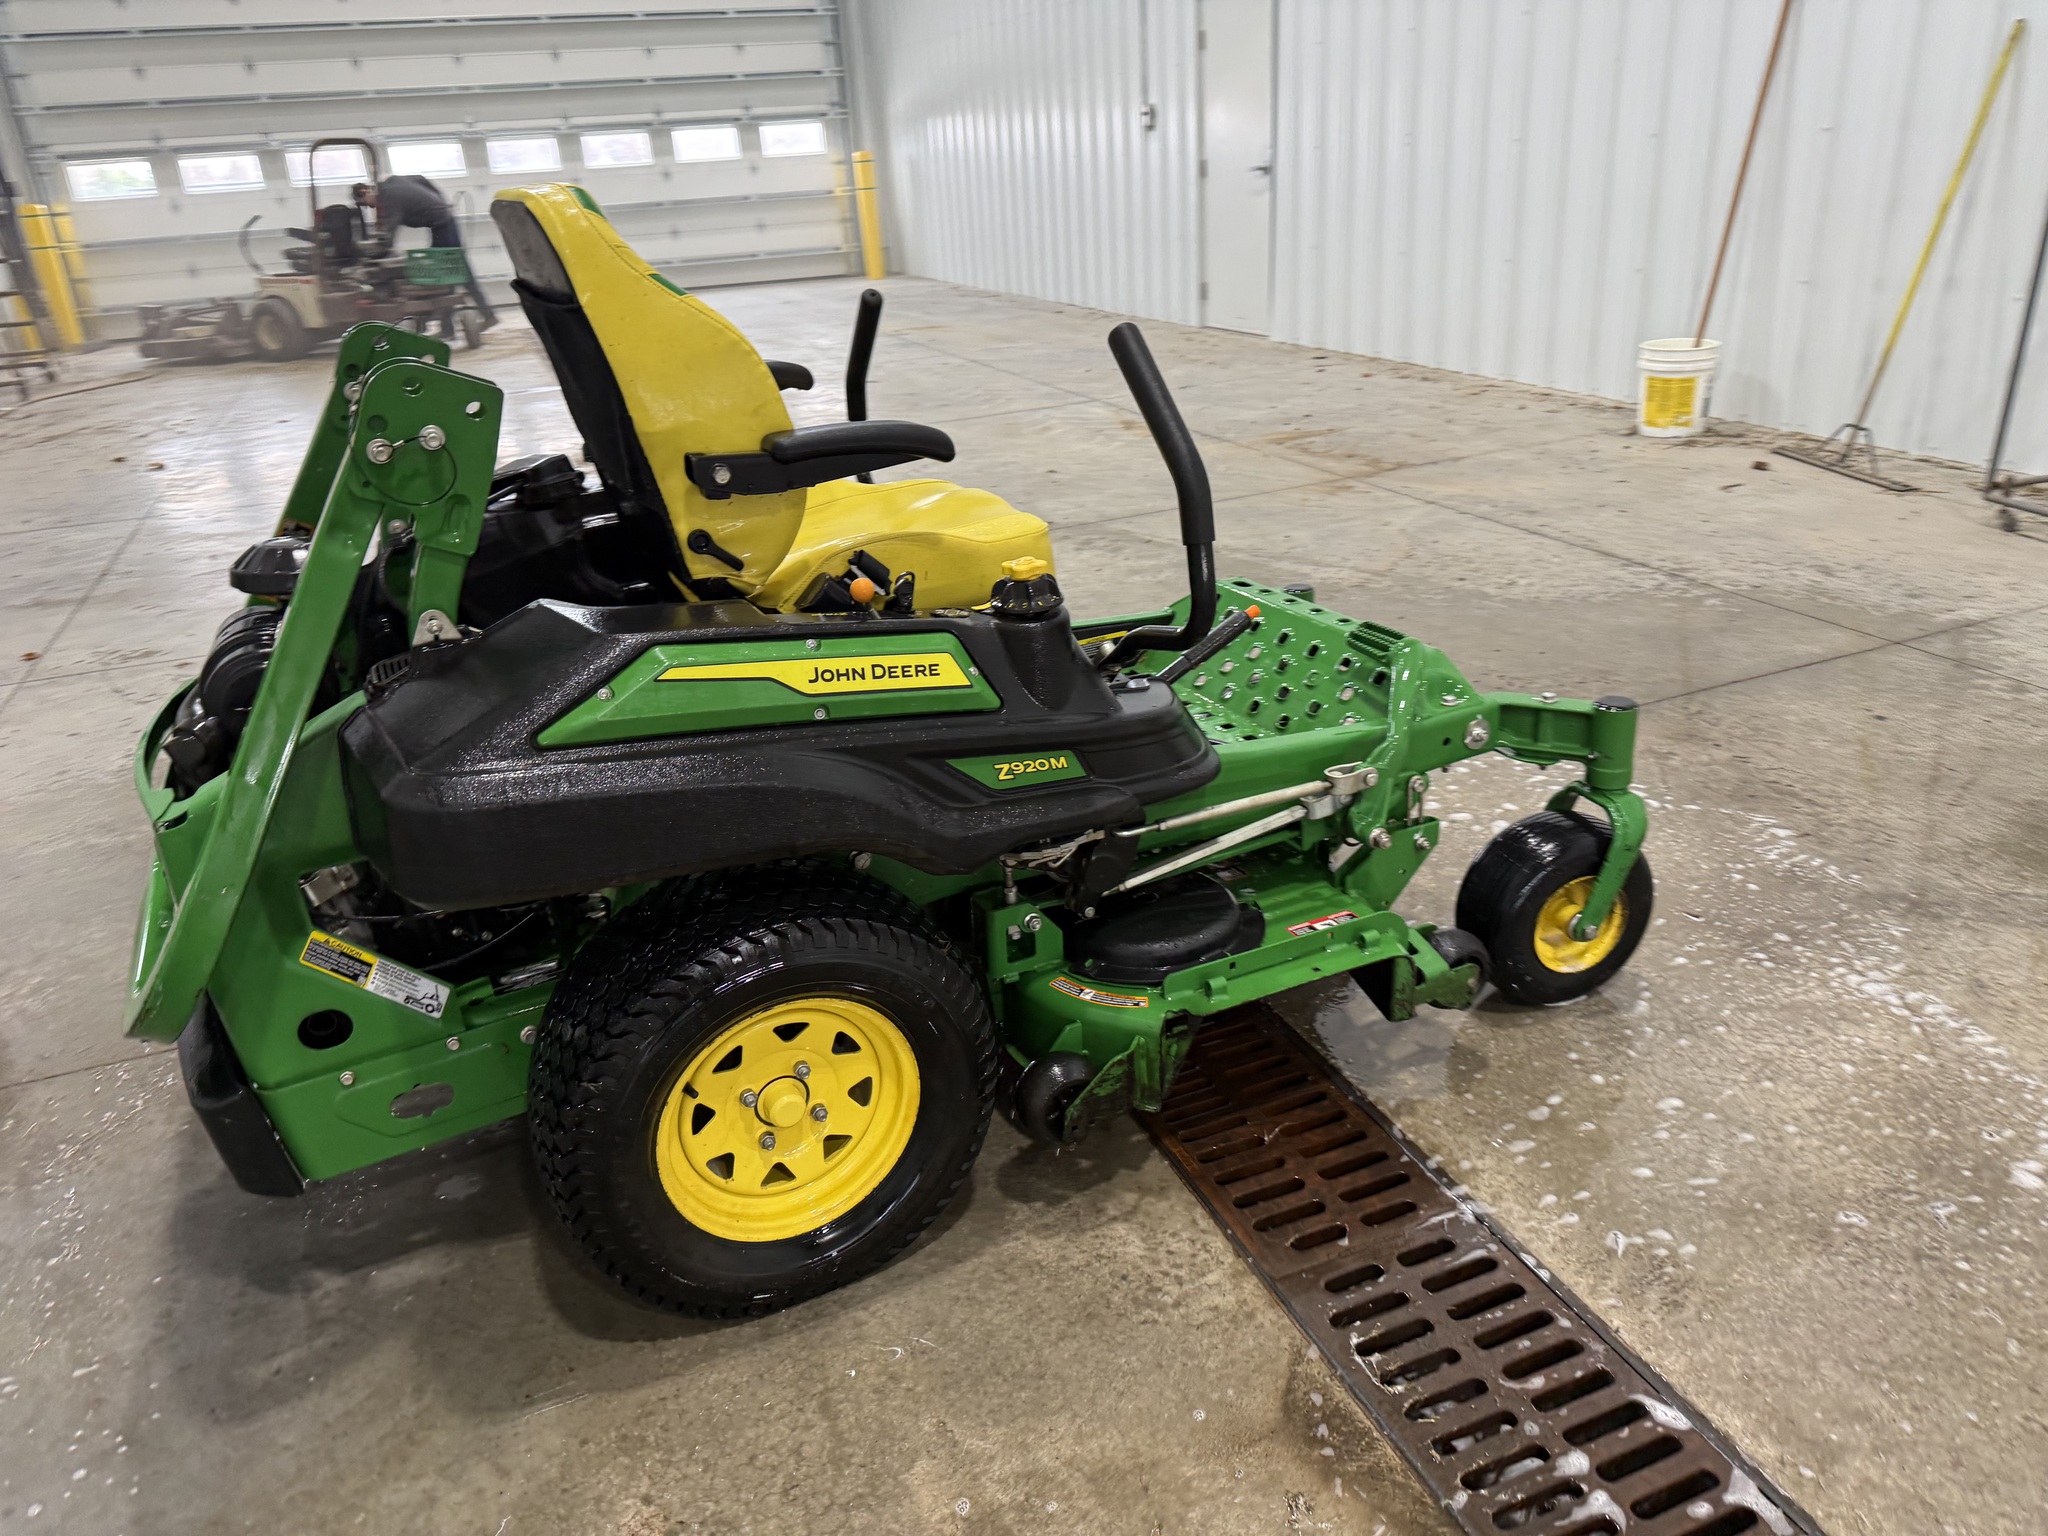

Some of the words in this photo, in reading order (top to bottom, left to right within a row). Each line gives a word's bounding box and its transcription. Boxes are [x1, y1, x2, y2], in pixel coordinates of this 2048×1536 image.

[808, 667, 866, 684] JOHN
[871, 664, 941, 680] DEERE
[994, 756, 1069, 780] Z920M
[331, 940, 363, 959] CAUTION
